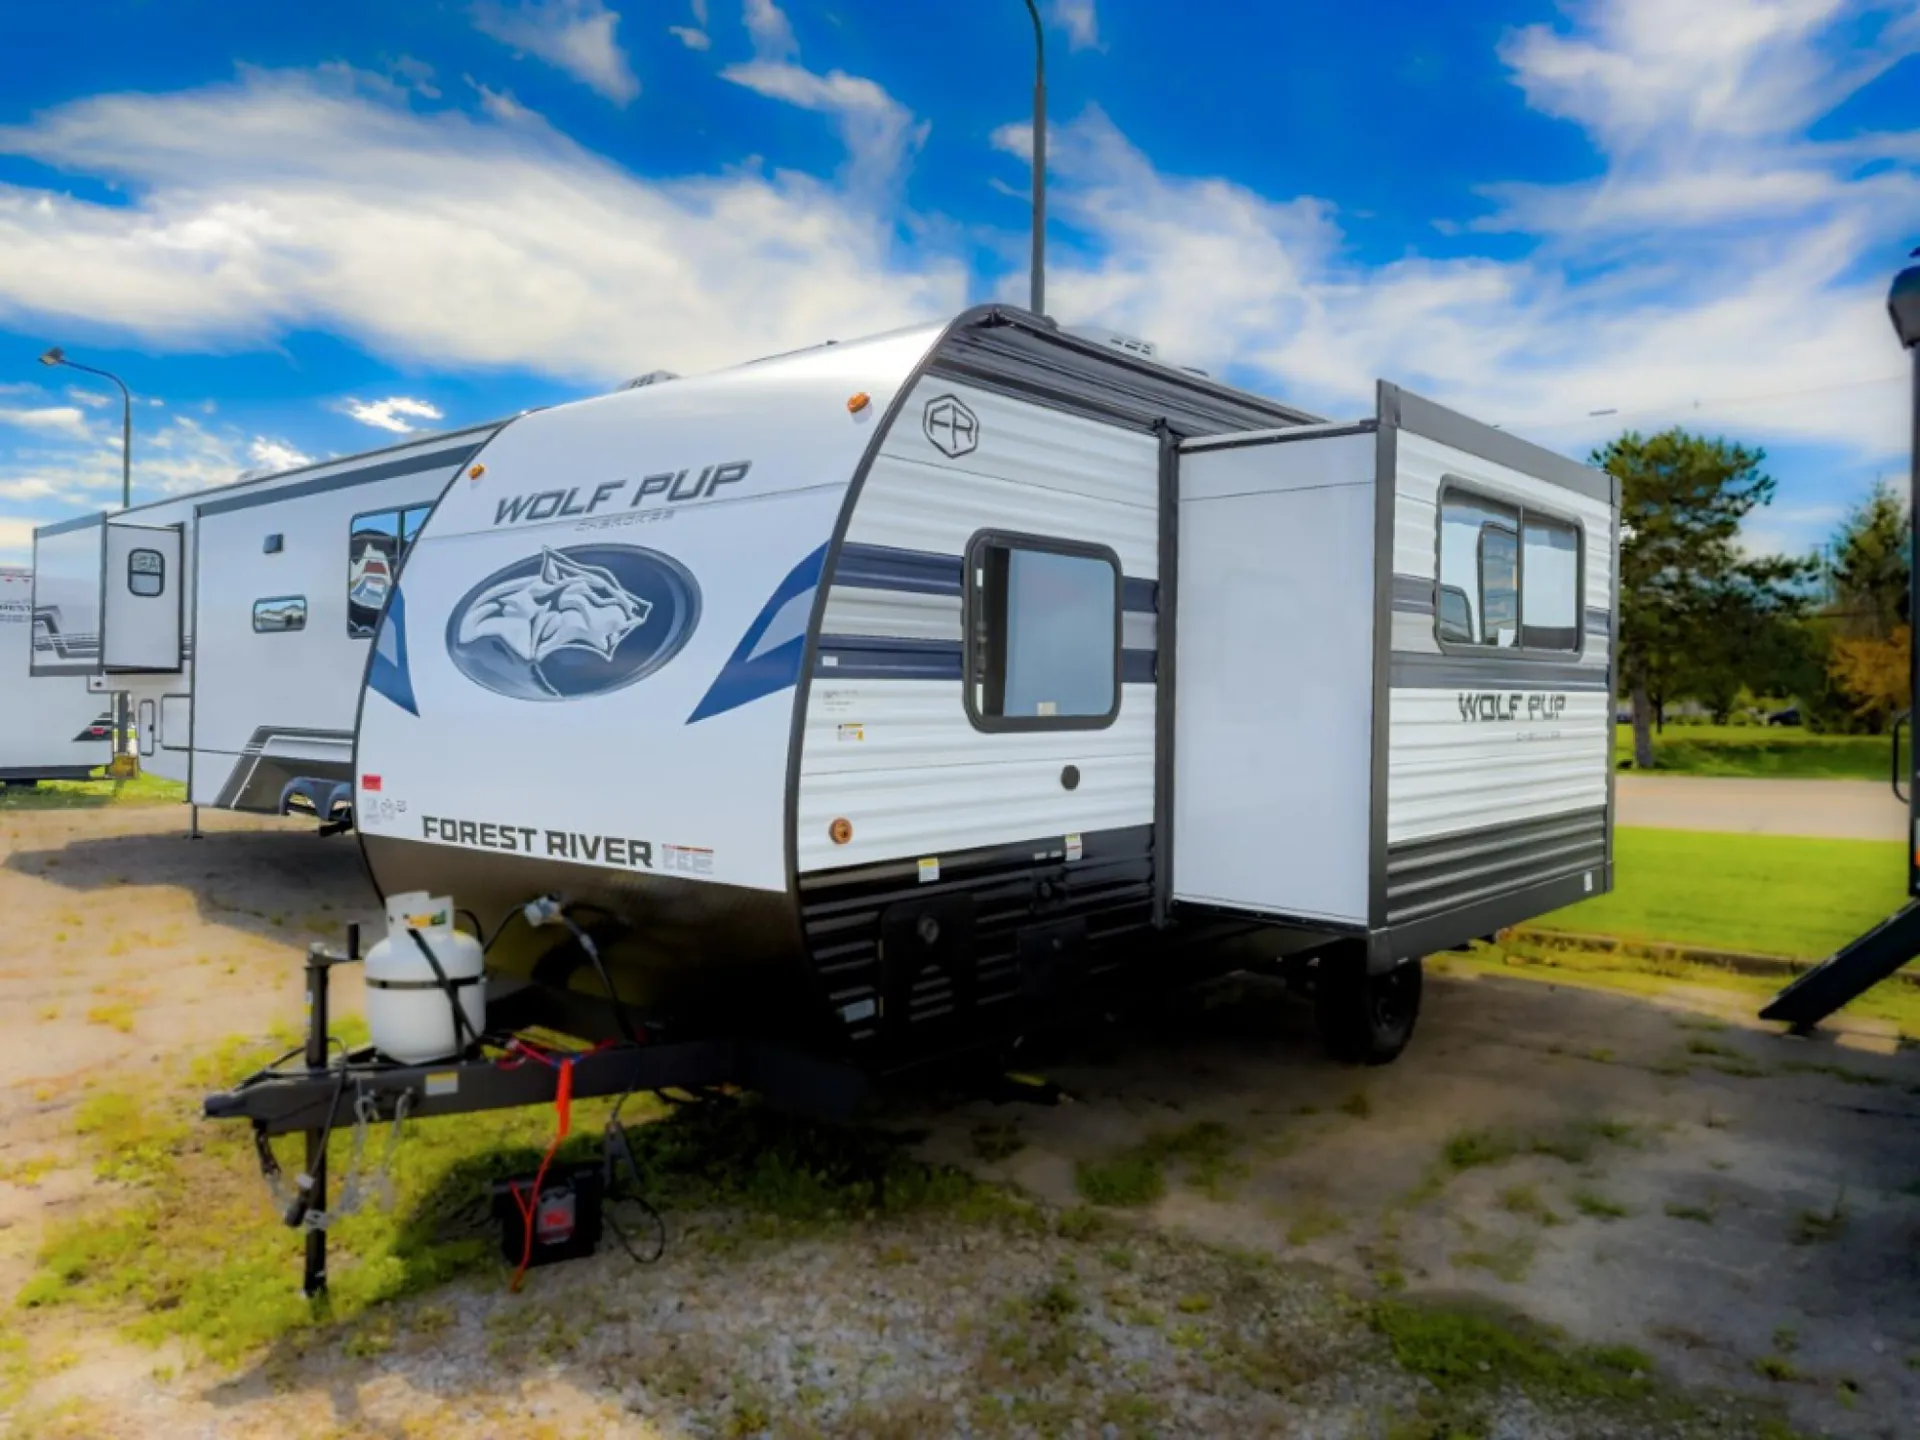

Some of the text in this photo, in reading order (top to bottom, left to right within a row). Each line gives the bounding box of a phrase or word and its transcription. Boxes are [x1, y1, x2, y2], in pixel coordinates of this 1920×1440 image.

[494, 460, 752, 525] WOLF PUP
[1458, 692, 1566, 722] WOLF PUP
[422, 815, 538, 852] FOREST
[544, 829, 653, 868] RIVER
